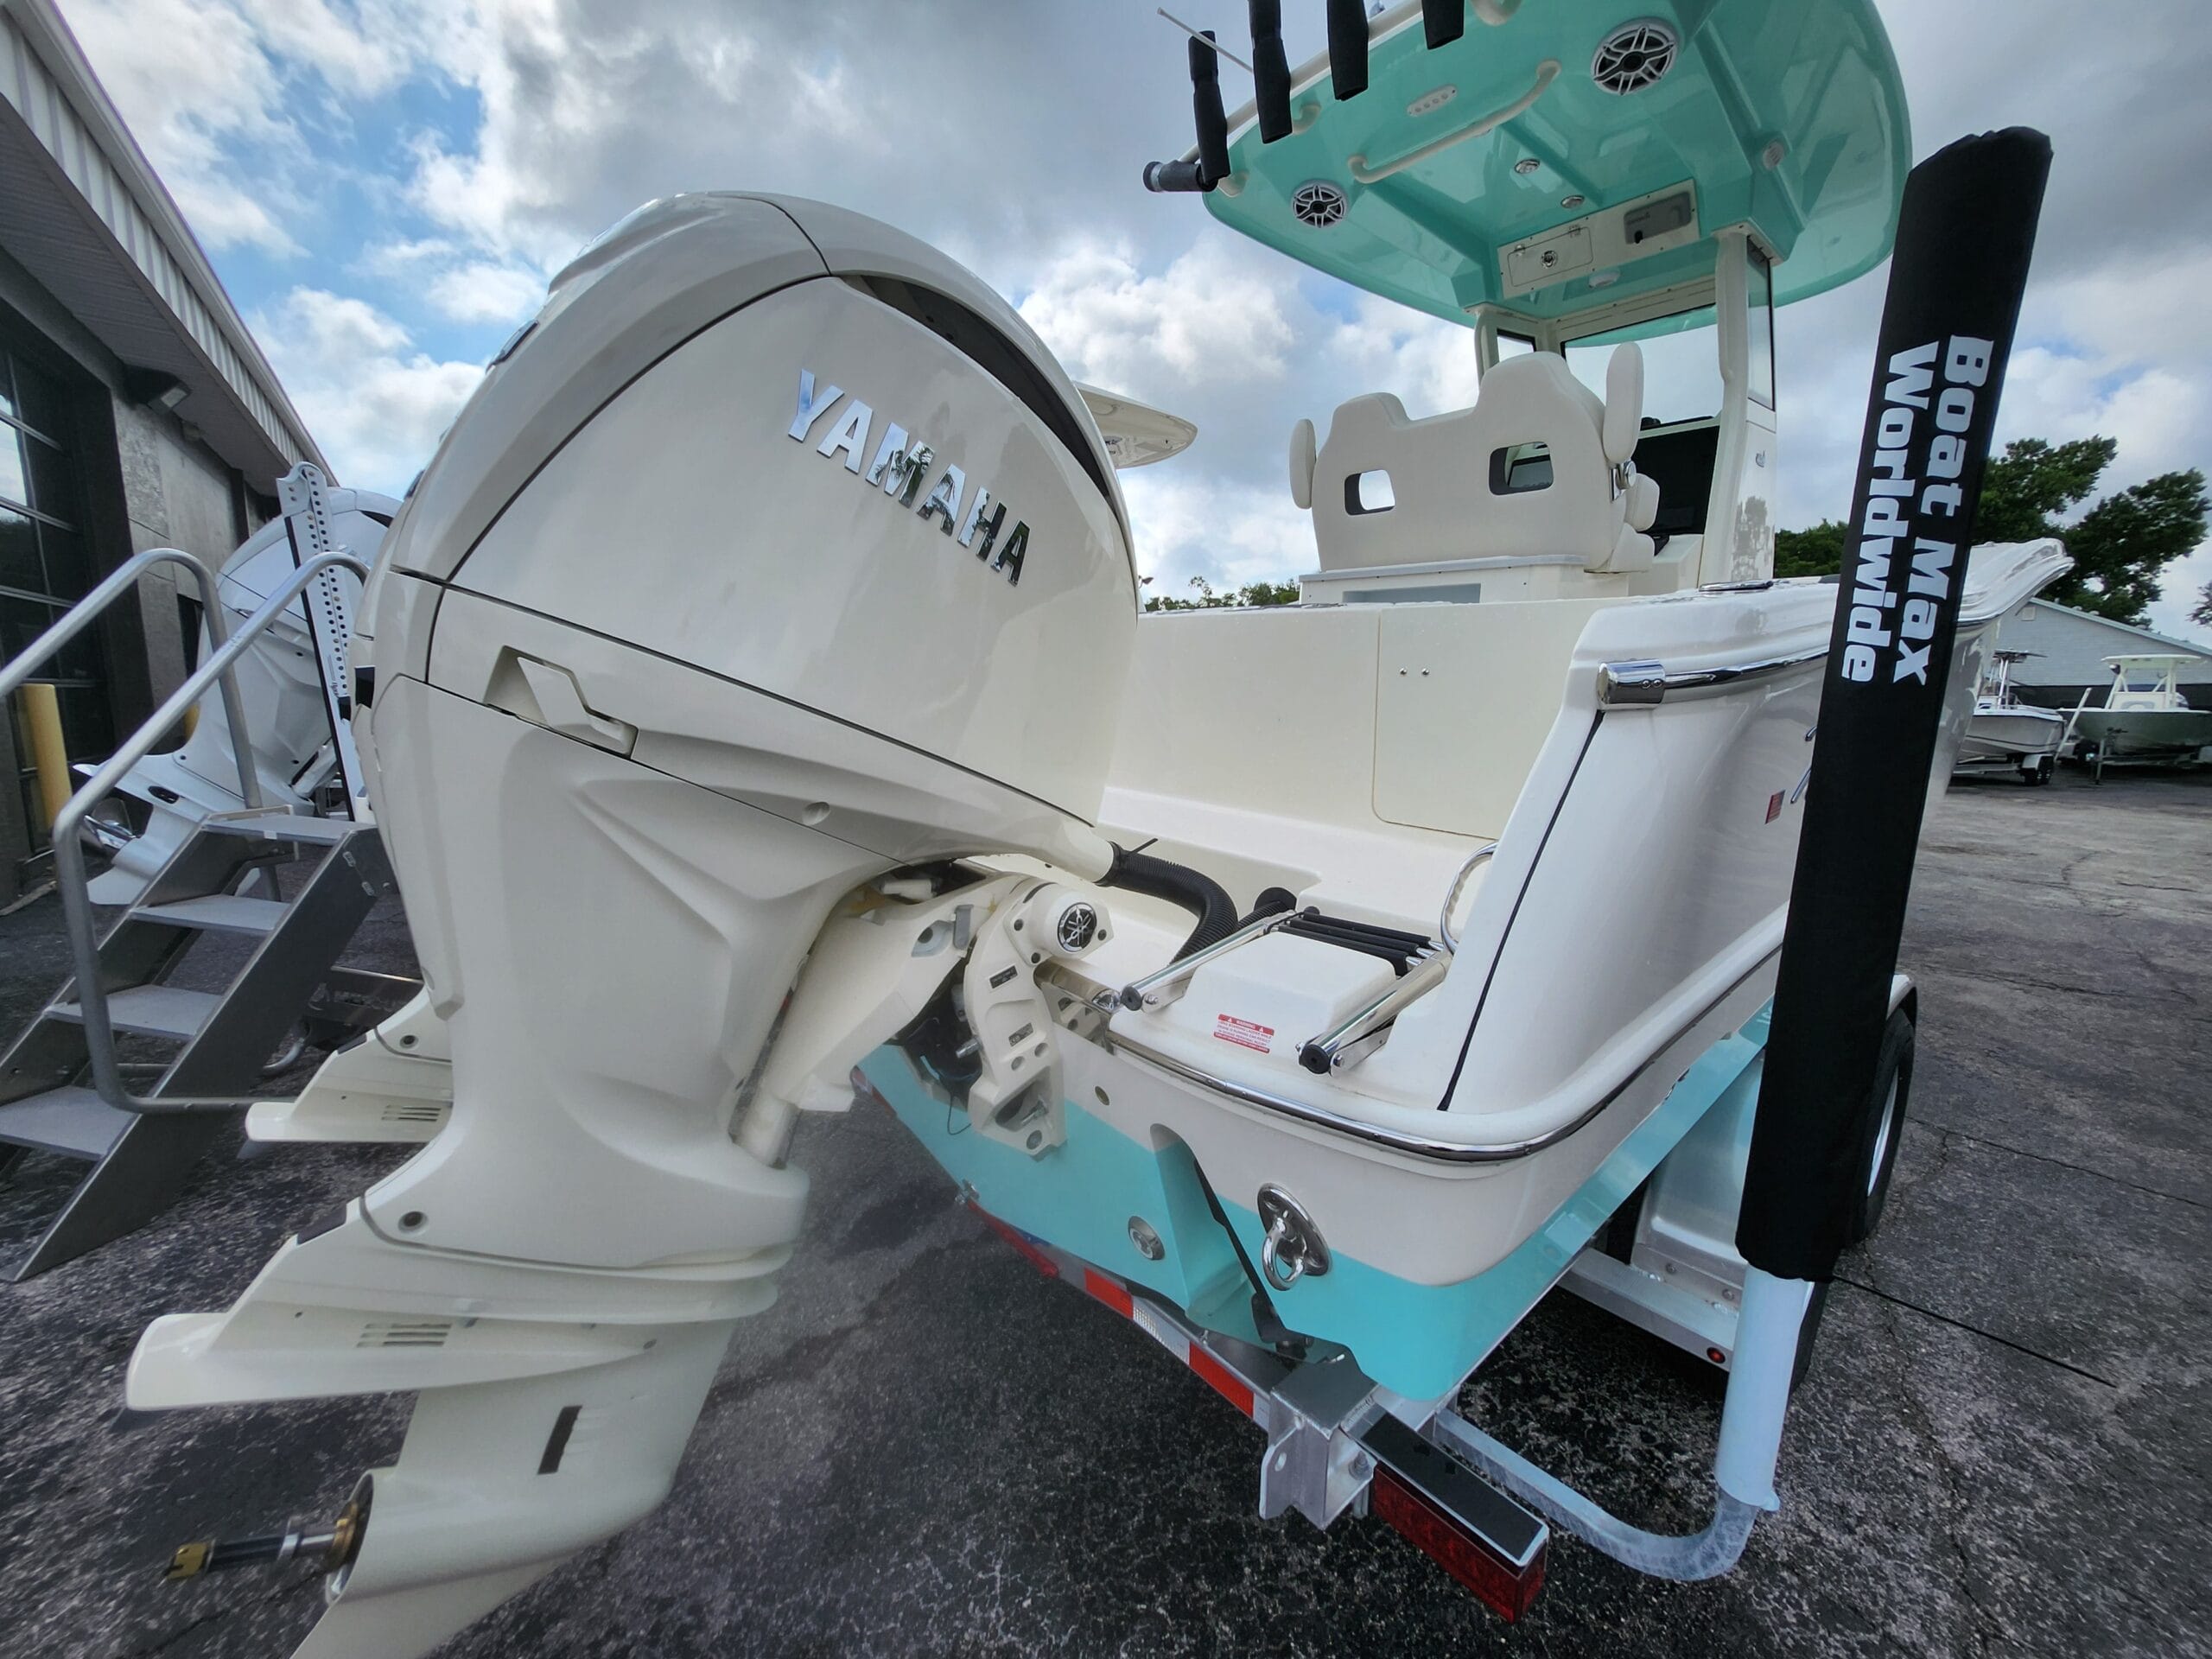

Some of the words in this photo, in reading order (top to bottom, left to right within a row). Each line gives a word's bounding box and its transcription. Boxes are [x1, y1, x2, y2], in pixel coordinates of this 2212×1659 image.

[788, 368, 1030, 587] YAMAHA
[1841, 340, 1939, 683] Worldwide
[1920, 334, 1994, 517] Boat
[1892, 537, 1957, 685] Max
